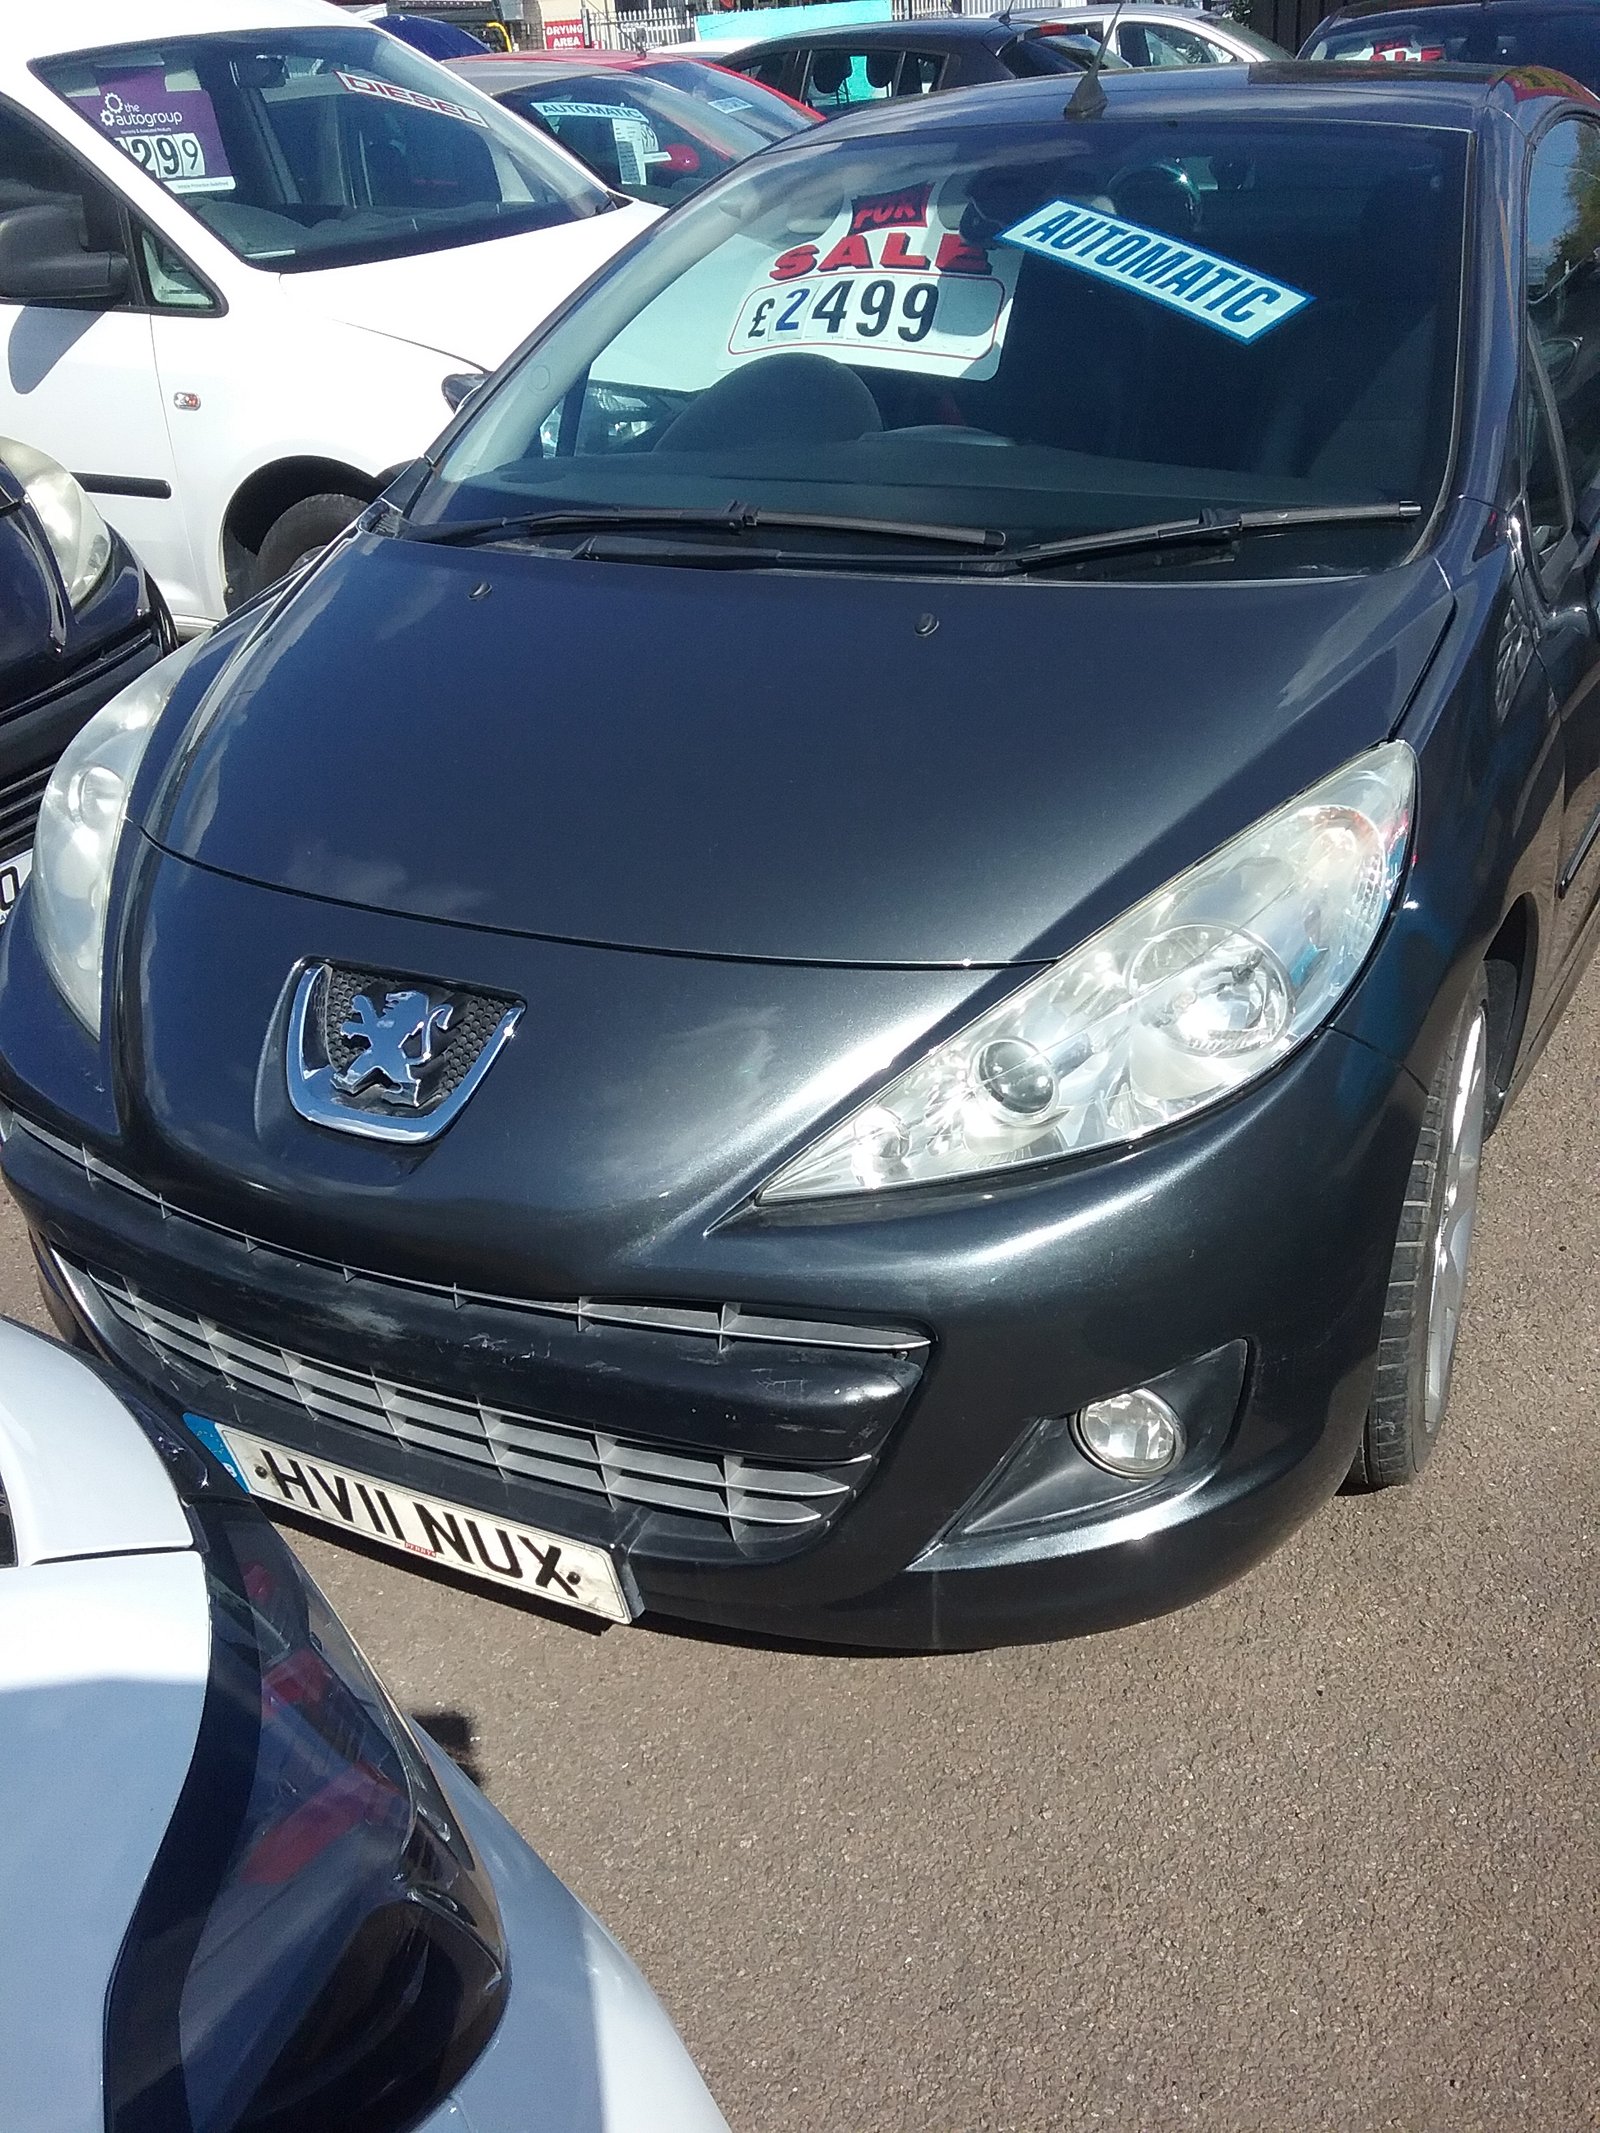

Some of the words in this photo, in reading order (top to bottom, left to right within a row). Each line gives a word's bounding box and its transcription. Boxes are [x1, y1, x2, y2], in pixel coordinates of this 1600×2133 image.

[546, 24, 583, 36] DRYING
[553, 36, 580, 48] AREA
[124, 103, 140, 113] the
[346, 76, 483, 124] DIESEL
[541, 103, 644, 119] AUTOMATIC
[116, 111, 183, 127] autogroup
[769, 232, 993, 281] SALE
[1021, 209, 1282, 324] AUTOMATIC
[748, 279, 940, 343] £2499
[412, 1501, 580, 1599] NUX
